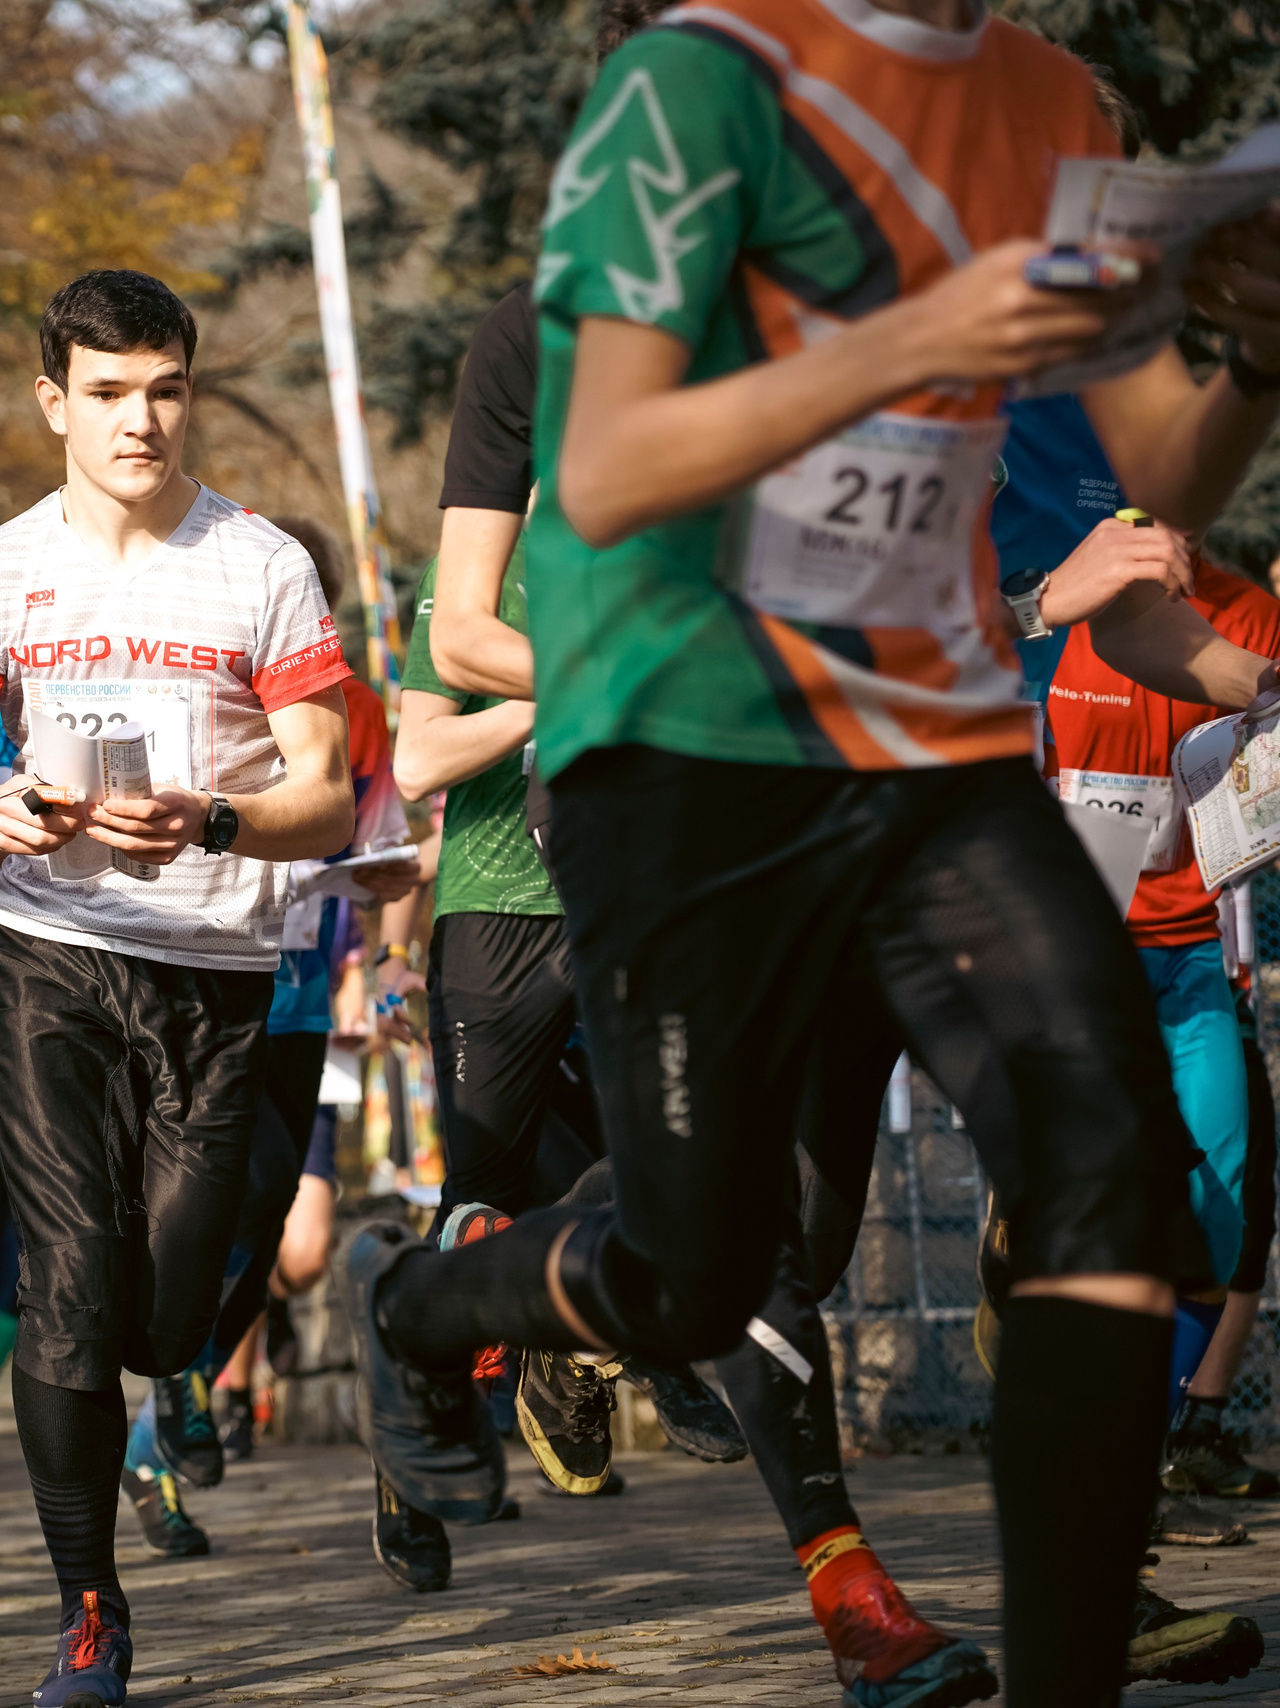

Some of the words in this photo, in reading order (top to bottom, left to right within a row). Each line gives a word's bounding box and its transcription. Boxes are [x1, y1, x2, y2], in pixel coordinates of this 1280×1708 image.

[825, 466, 945, 534] 212
[9, 634, 112, 668] NORD
[125, 637, 245, 671] WEST
[45, 684, 96, 695] ПЕРВЕНСТВО
[98, 684, 131, 695] РОССИИ
[147, 730, 155, 752] 1
[1153, 815, 1161, 832] 1
